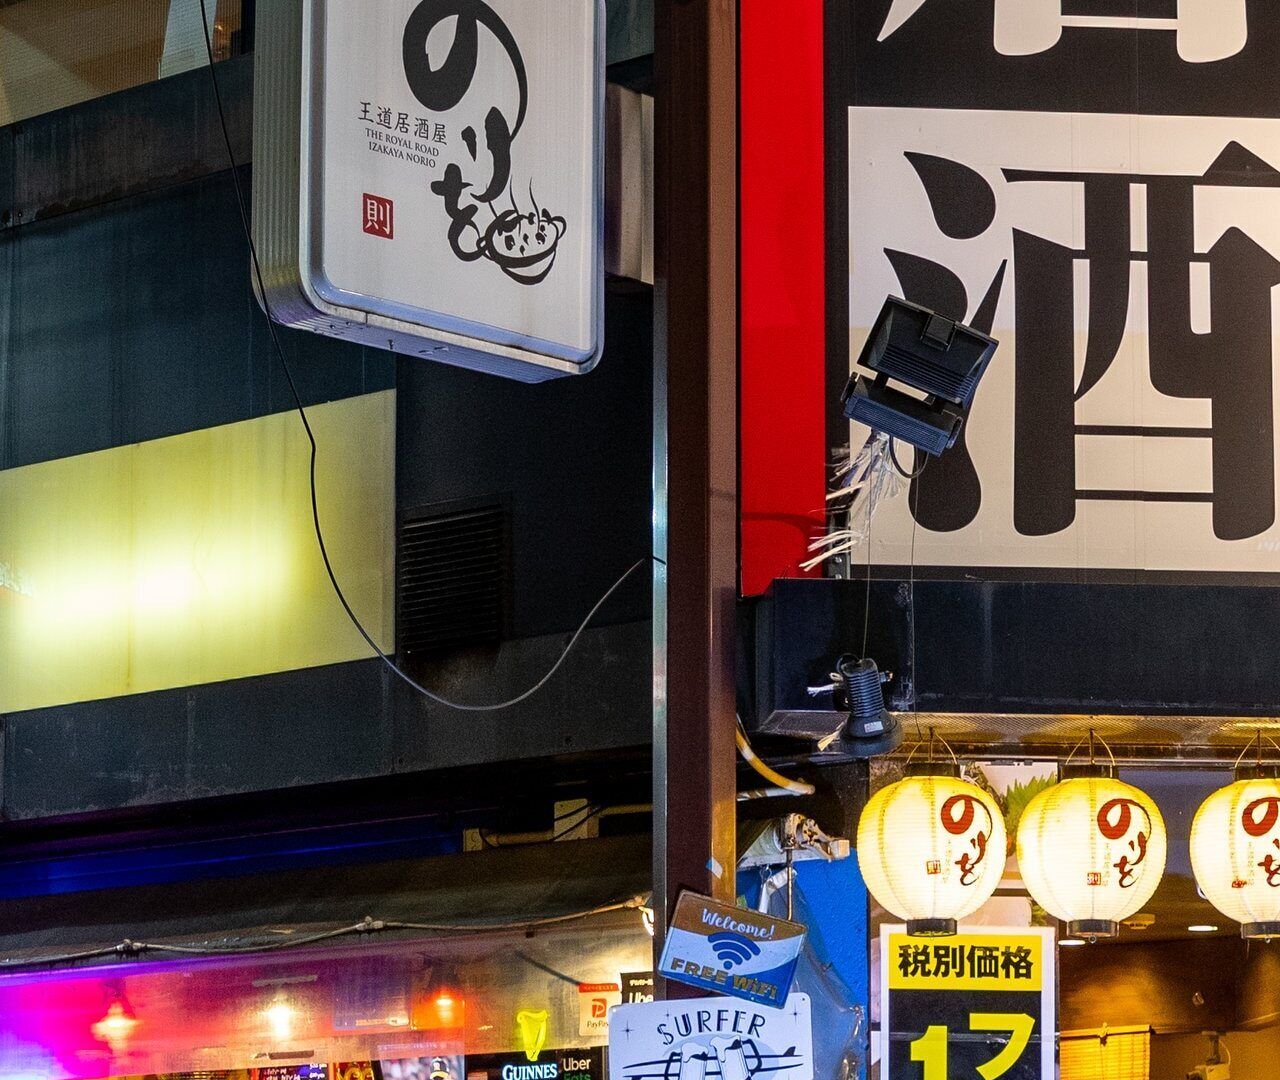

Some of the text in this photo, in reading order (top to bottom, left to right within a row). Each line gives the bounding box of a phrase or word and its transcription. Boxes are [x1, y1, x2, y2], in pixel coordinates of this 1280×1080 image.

[358, 101, 447, 147] 王道居酒屋
[365, 128, 439, 158] THE ROYAL ROAD
[368, 142, 436, 169] IZAKAYA NORIO
[940, 794, 994, 888] のりを
[1096, 797, 1152, 888] のりを
[701, 907, 776, 940] Welcome!
[670, 957, 726, 986] FREE
[898, 943, 1035, 980] 税別価格
[657, 1009, 767, 1047] SURFER
[562, 1057, 592, 1072] Uber
